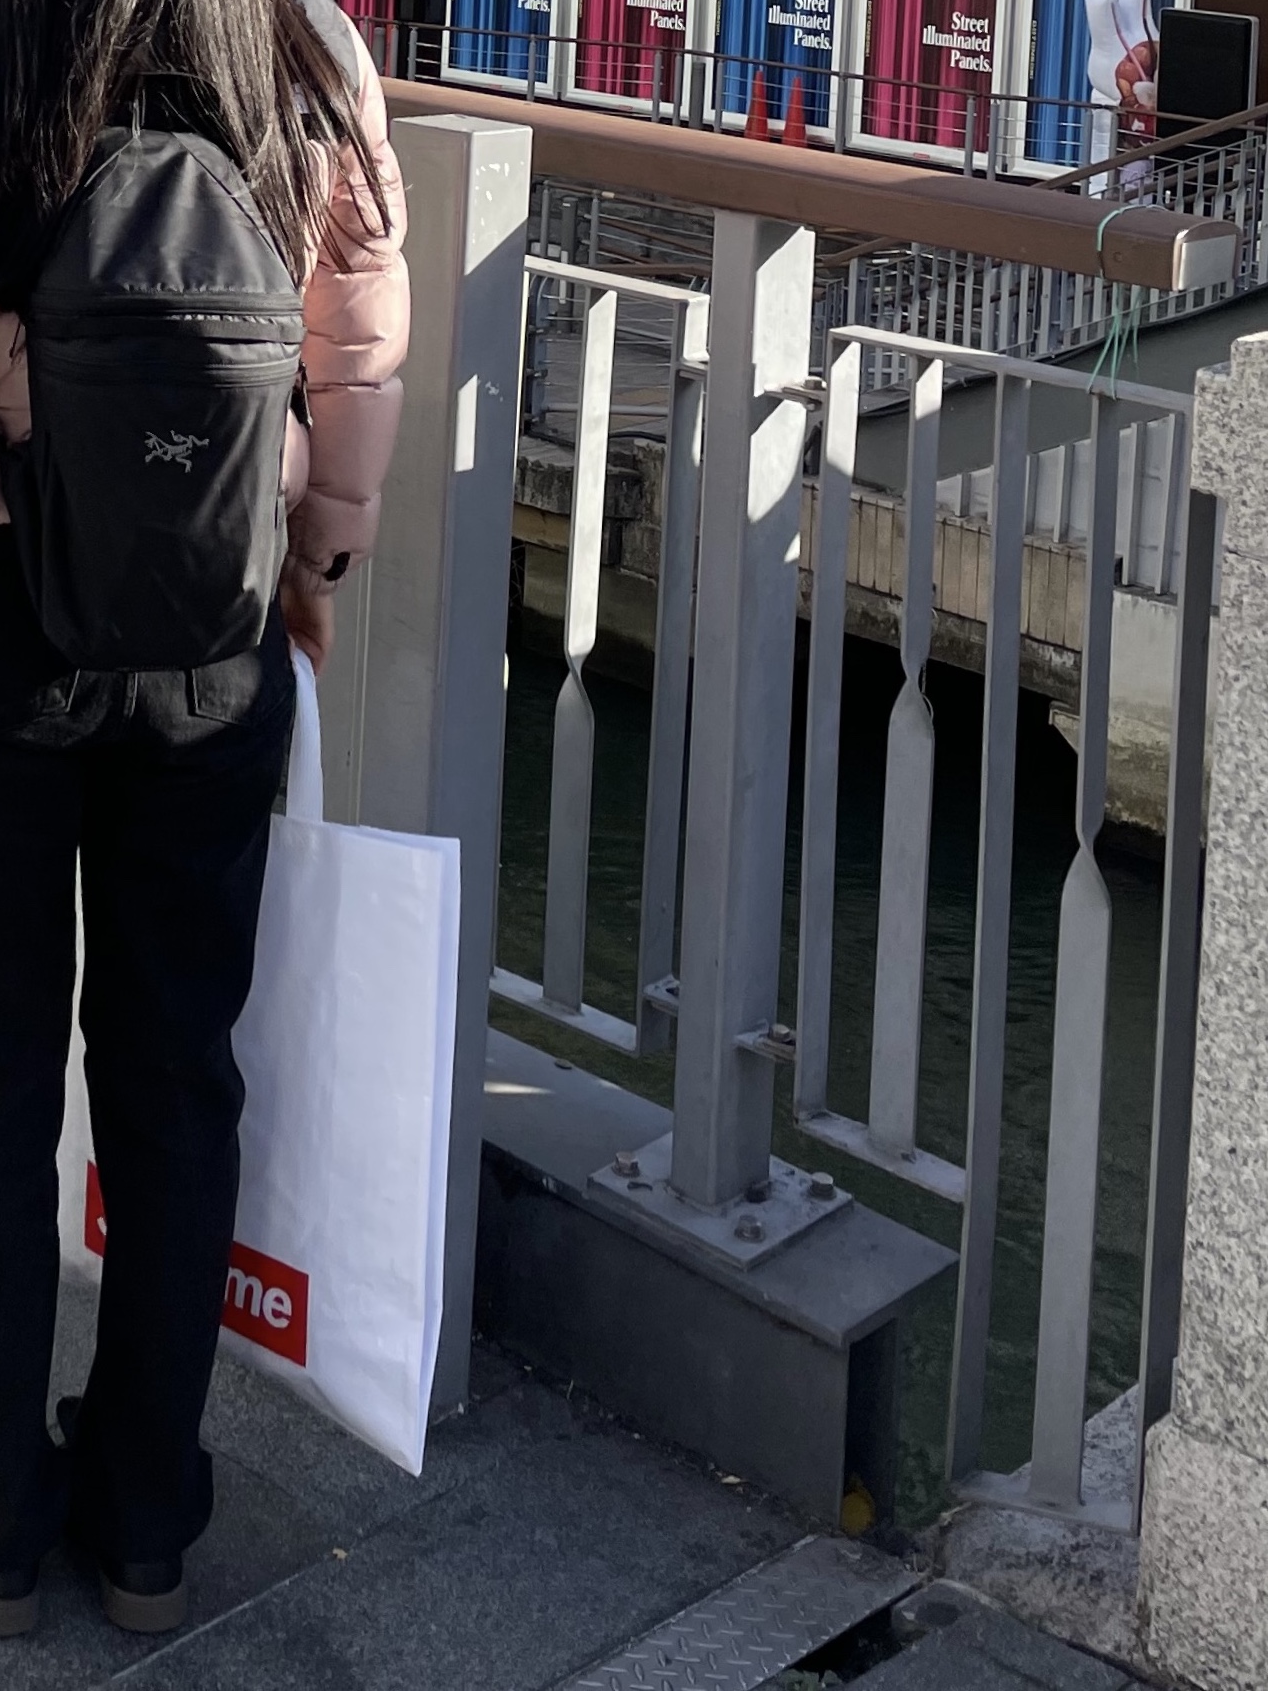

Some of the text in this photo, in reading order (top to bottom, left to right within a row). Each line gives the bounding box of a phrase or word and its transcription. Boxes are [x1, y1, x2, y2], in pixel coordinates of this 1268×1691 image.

[650, 10, 686, 31] Panels.
[951, 11, 989, 34] Street
[793, 28, 832, 50] Panels.
[950, 48, 993, 73] Panels.
